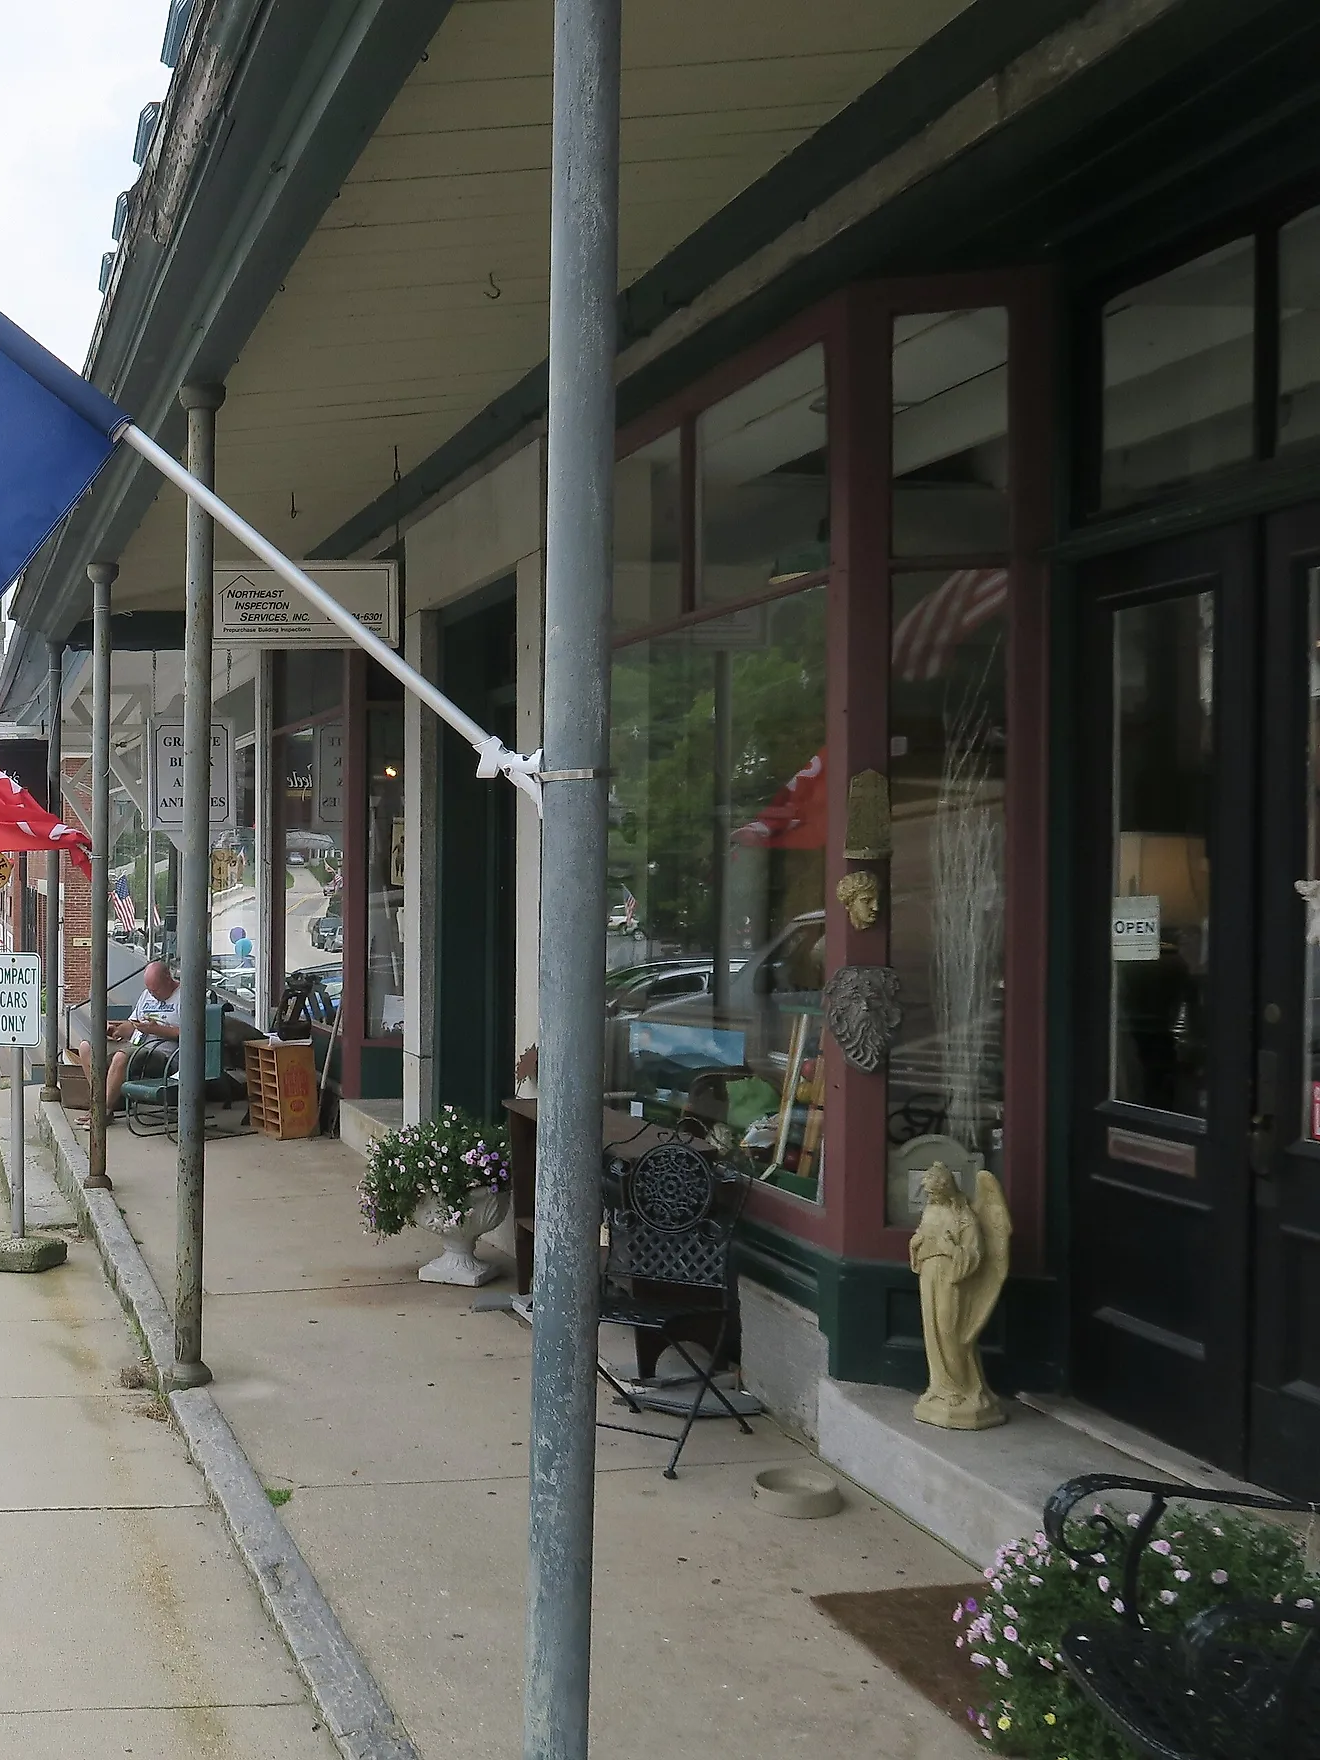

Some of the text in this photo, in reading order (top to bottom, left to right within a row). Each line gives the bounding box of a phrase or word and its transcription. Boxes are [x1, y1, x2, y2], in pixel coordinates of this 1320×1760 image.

[227, 590, 284, 599] NORTHEAST
[235, 601, 289, 610] INSPECTION
[240, 612, 289, 622] SERVICES,
[292, 613, 310, 622] INC.
[1114, 920, 1156, 934] OPEN
[0, 991, 27, 1008] CARS
[1, 1015, 26, 1031] ONLY
